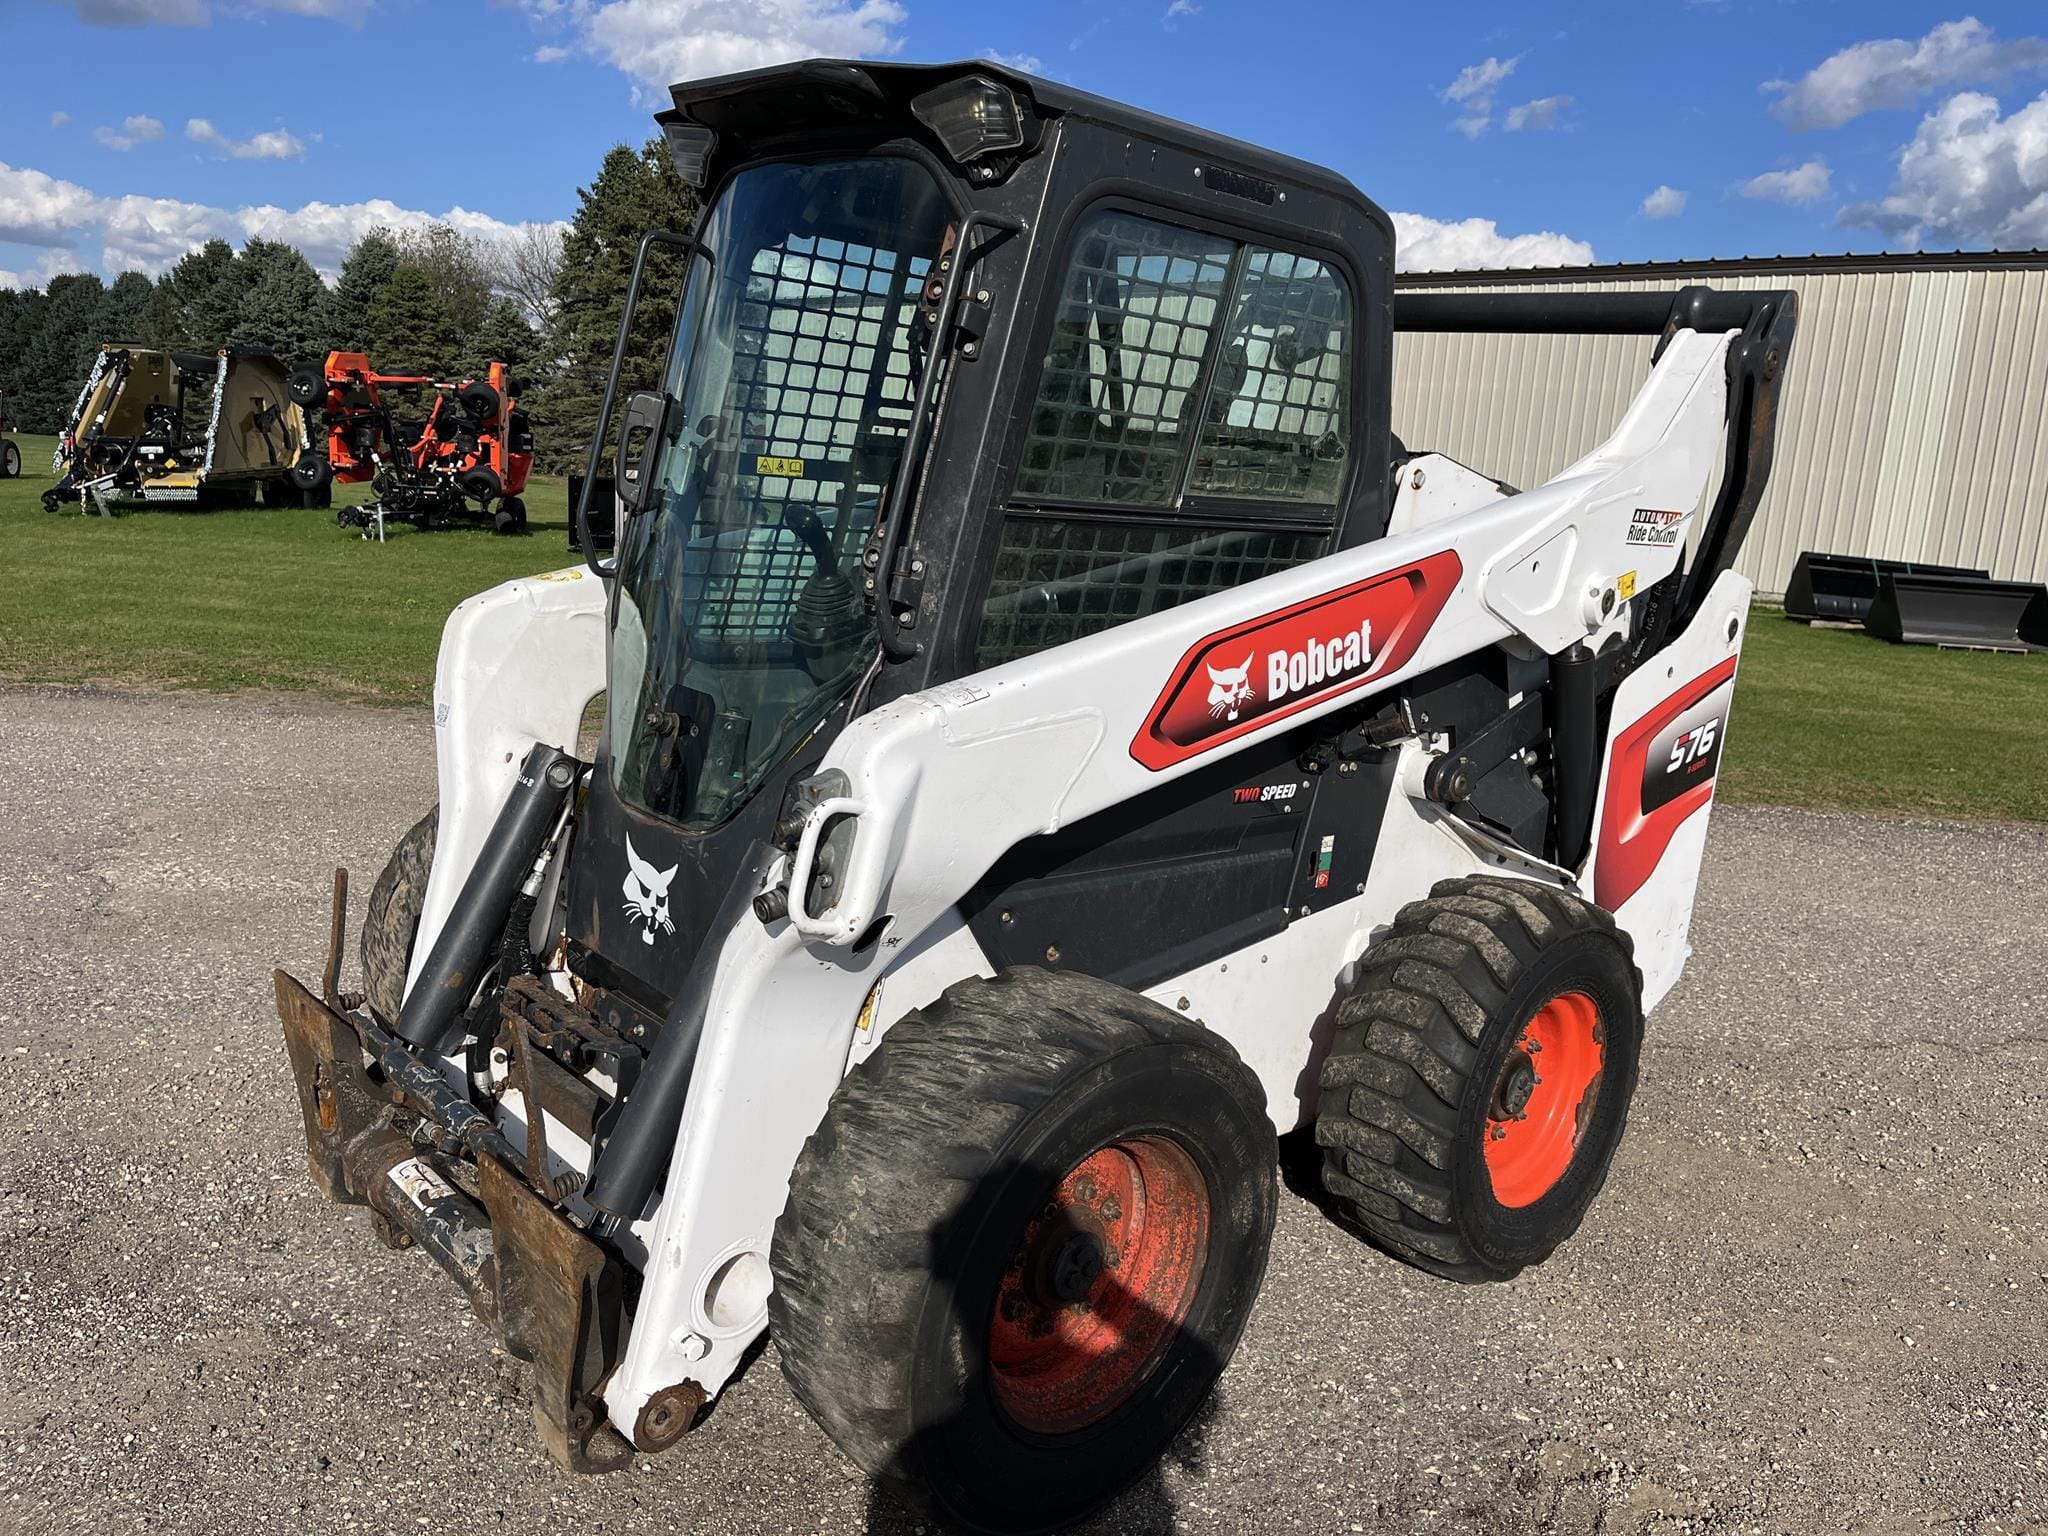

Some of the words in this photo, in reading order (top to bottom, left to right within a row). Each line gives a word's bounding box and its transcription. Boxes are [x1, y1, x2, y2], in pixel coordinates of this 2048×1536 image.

[1626, 525, 1647, 542] Ride
[1648, 526, 1679, 544] Control
[1267, 619, 1371, 701] Bobcat
[1666, 717, 1719, 774] S76
[1234, 787, 1260, 802] TWO
[1260, 783, 1297, 802] SPEED
